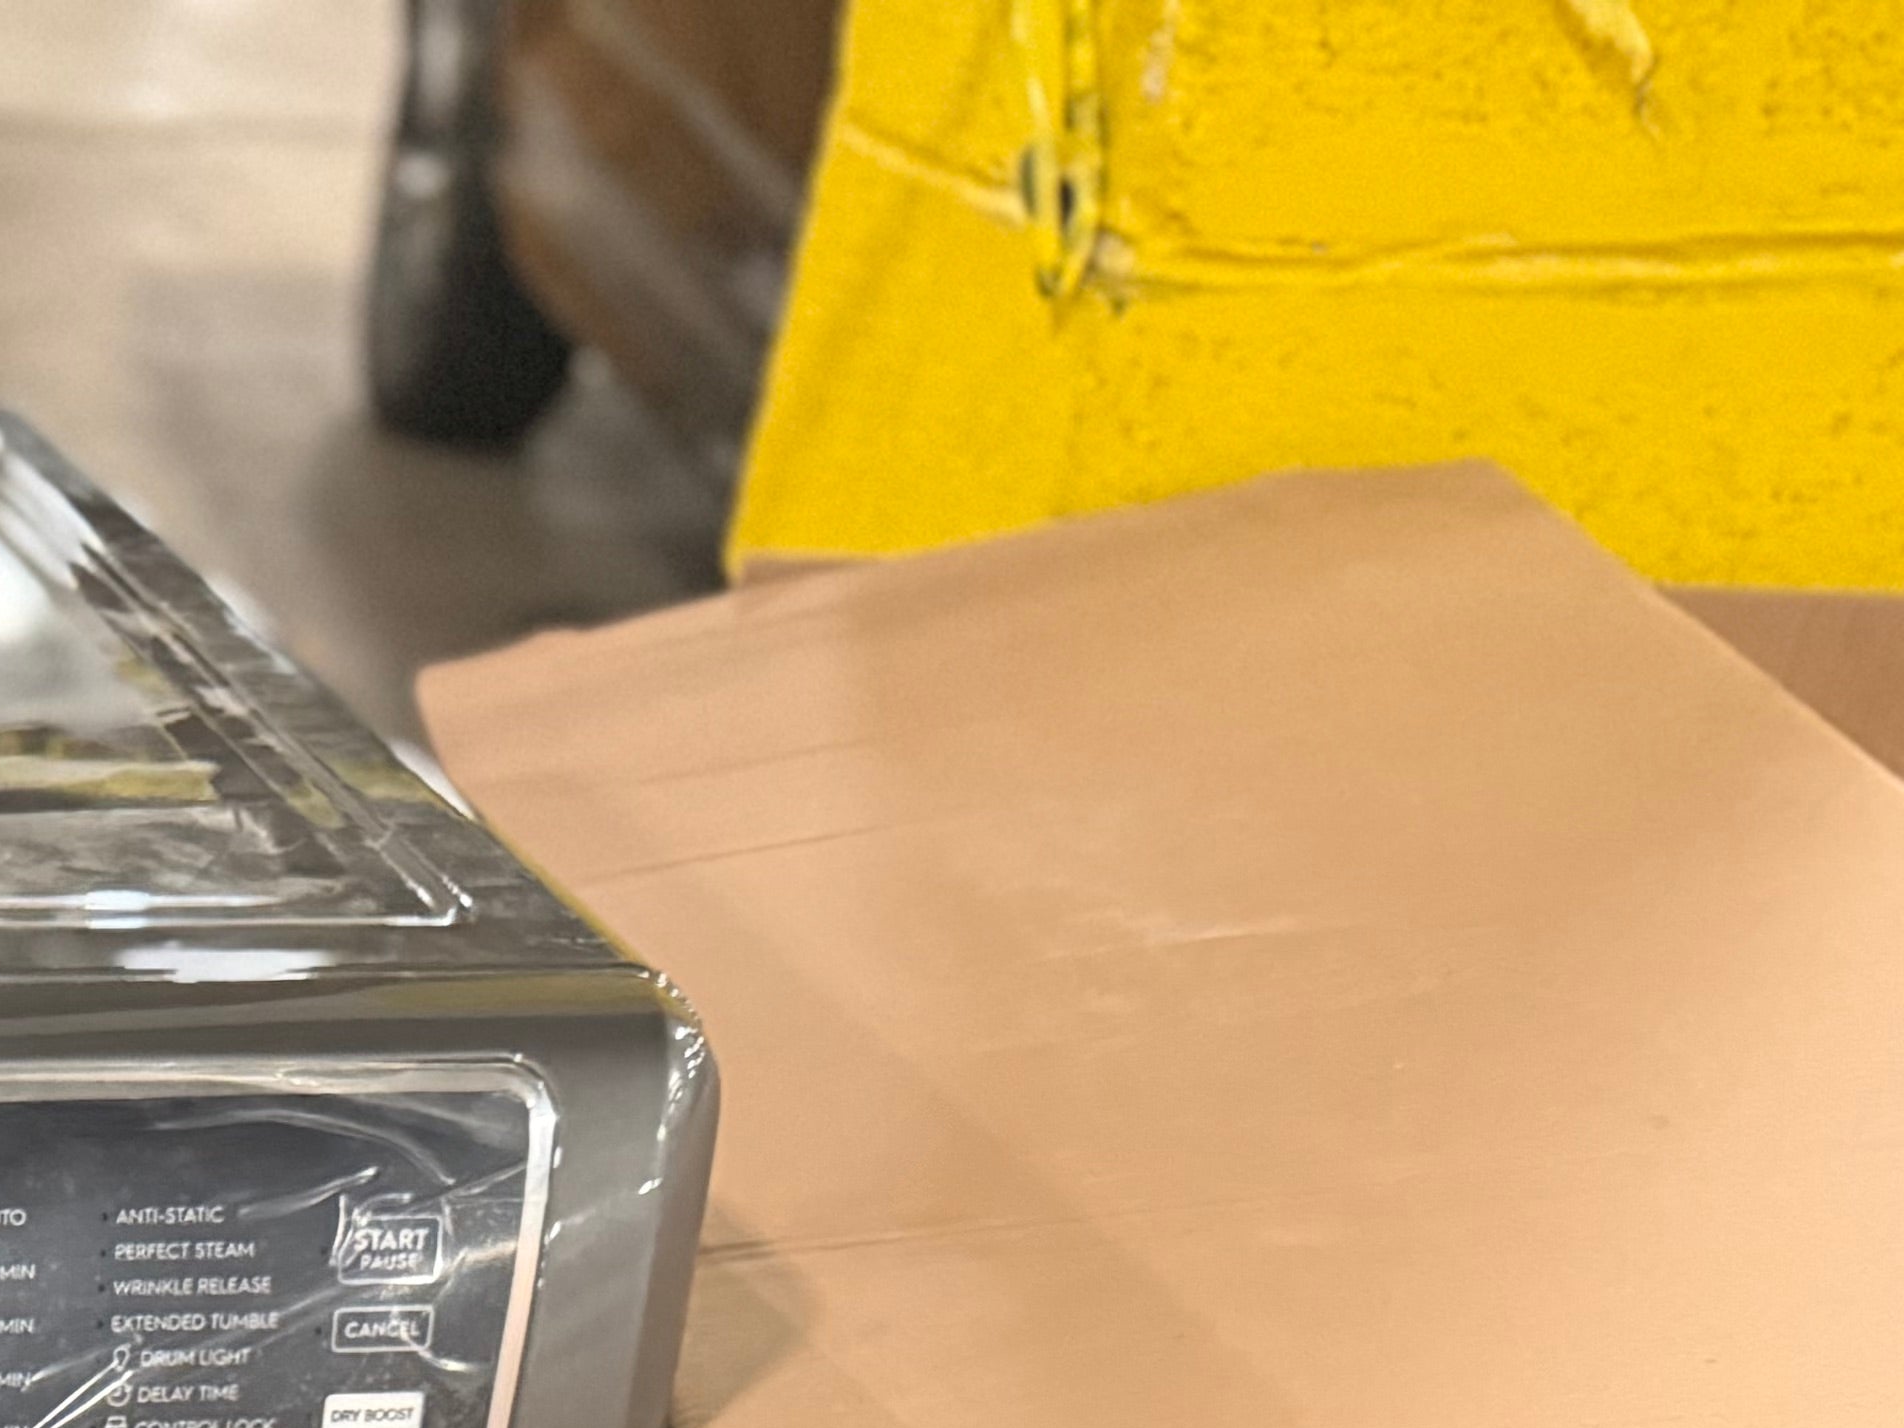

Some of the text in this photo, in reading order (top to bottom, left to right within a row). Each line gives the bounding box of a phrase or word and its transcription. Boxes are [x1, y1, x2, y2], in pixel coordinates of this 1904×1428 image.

[116, 1206, 225, 1225] ANTI-STATIC
[354, 1228, 429, 1251] START
[114, 1241, 255, 1261] PERFECT STEAM
[359, 1252, 420, 1271] PAUSE
[113, 1276, 272, 1296] WRINKLE RELEASE
[110, 1312, 280, 1333] EXTENDED TUMBLE
[344, 1321, 420, 1339] CANCEL
[140, 1348, 252, 1367] DRUM LIGHT
[137, 1384, 240, 1403] DELAY TIME
[331, 1407, 415, 1423] DRY BOOST
